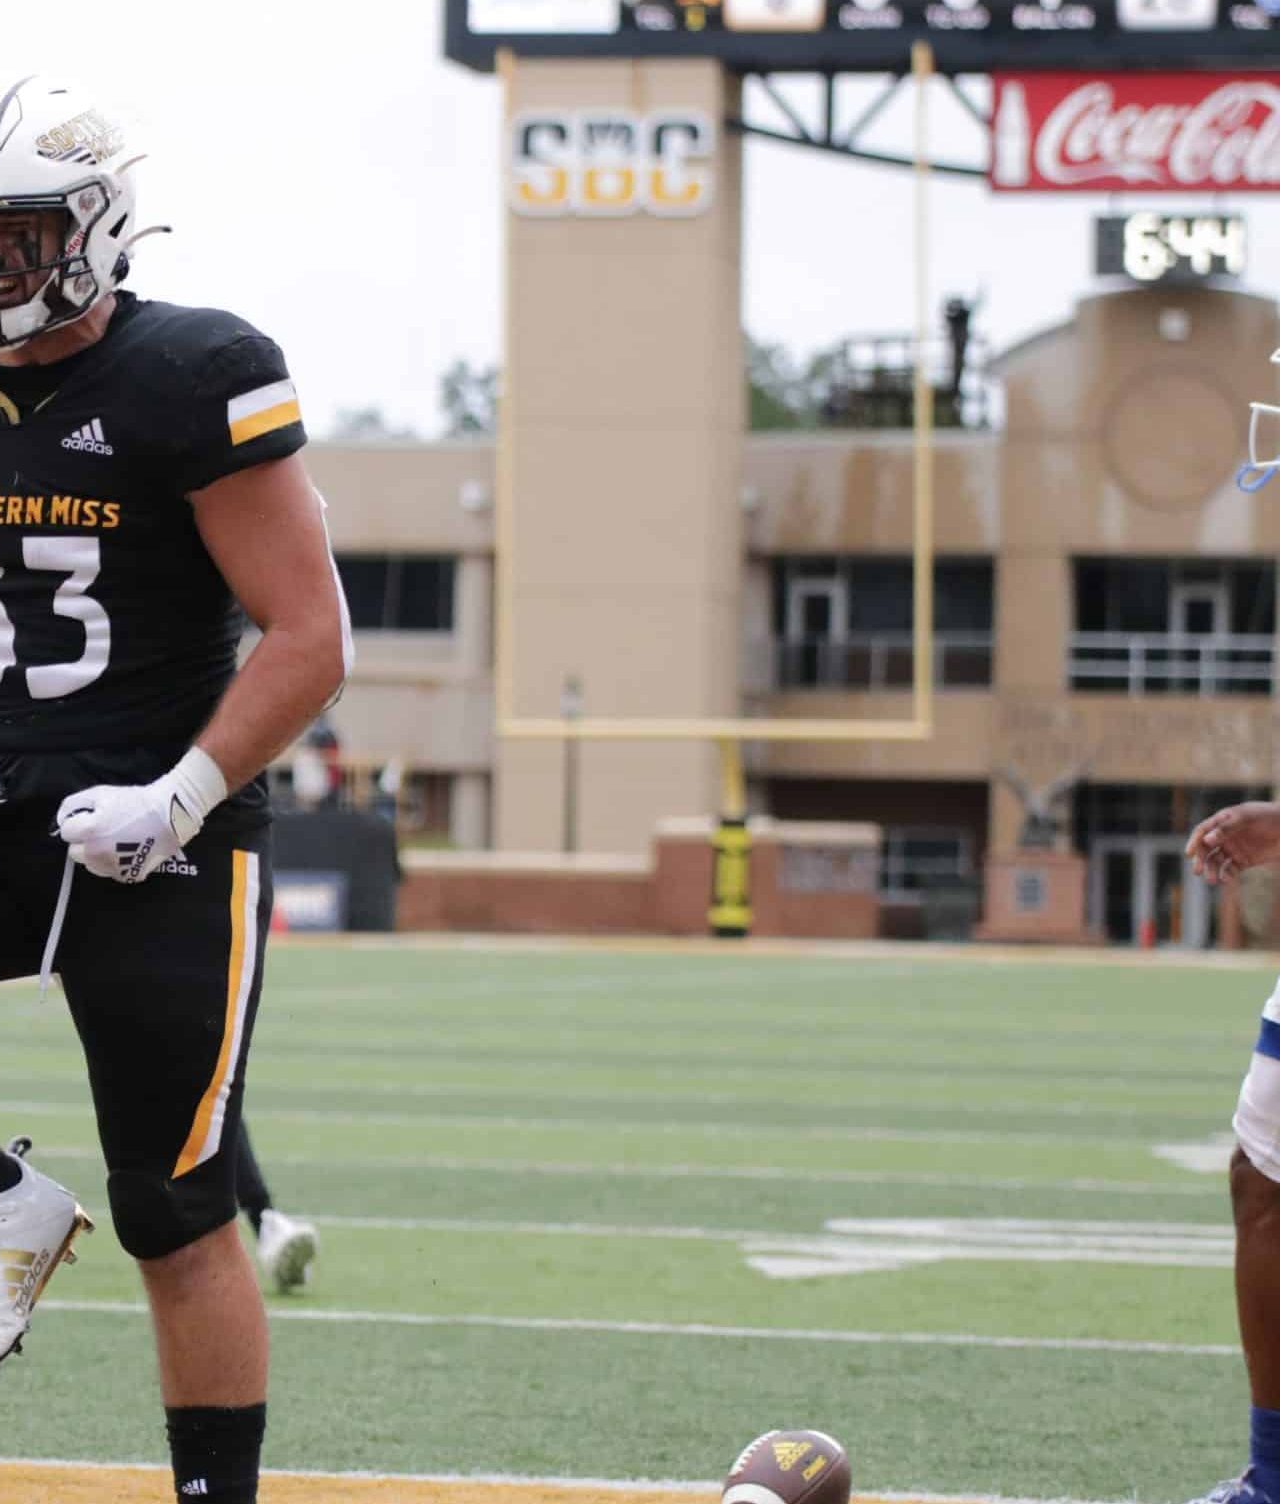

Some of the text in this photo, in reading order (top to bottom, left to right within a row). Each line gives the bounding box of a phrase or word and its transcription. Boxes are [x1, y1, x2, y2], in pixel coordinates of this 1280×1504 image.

[1035, 80, 1280, 184] Coca-Col
[516, 113, 706, 211] SBC
[1123, 212, 1247, 281] 6:44
[61, 438, 113, 455] adidas
[50, 496, 120, 528] MISS
[152, 858, 198, 877] idas
